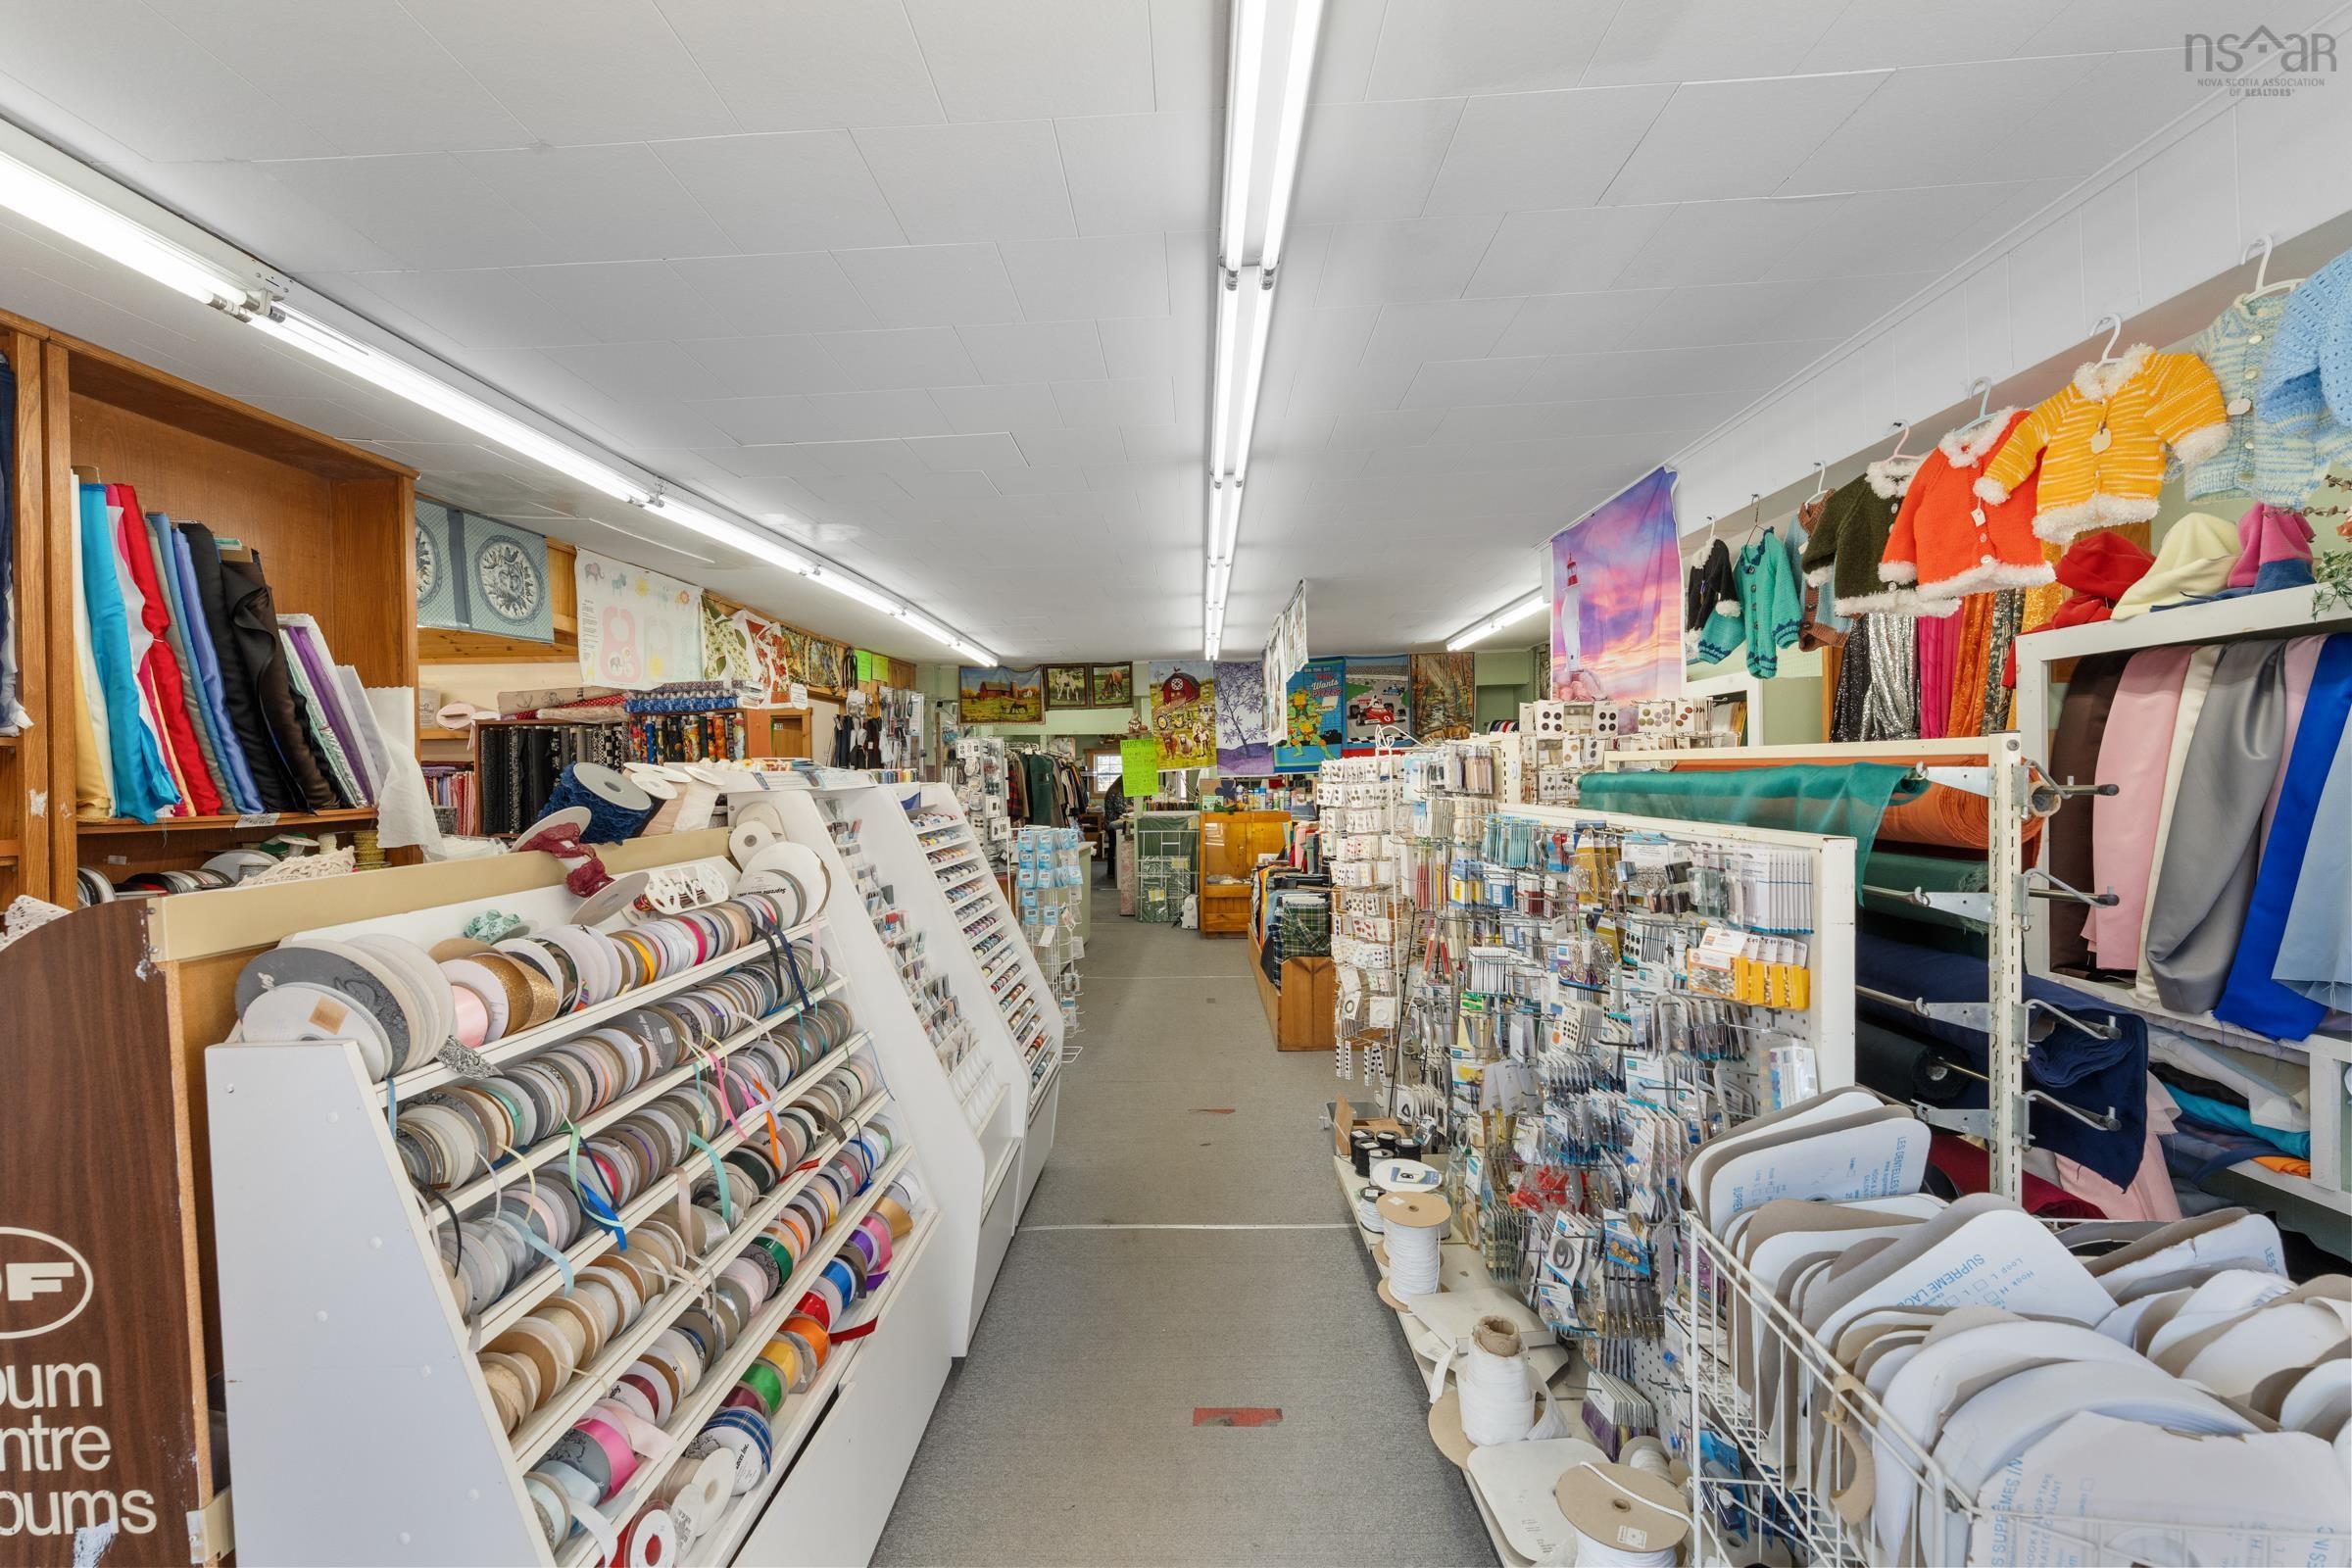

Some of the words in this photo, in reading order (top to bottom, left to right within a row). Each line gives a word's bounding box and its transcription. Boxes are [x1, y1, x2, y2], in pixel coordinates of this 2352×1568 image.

[1311, 679, 1339, 690] Wants
[1927, 1253, 1985, 1293] SUPREME
[0, 1362, 103, 1409] um
